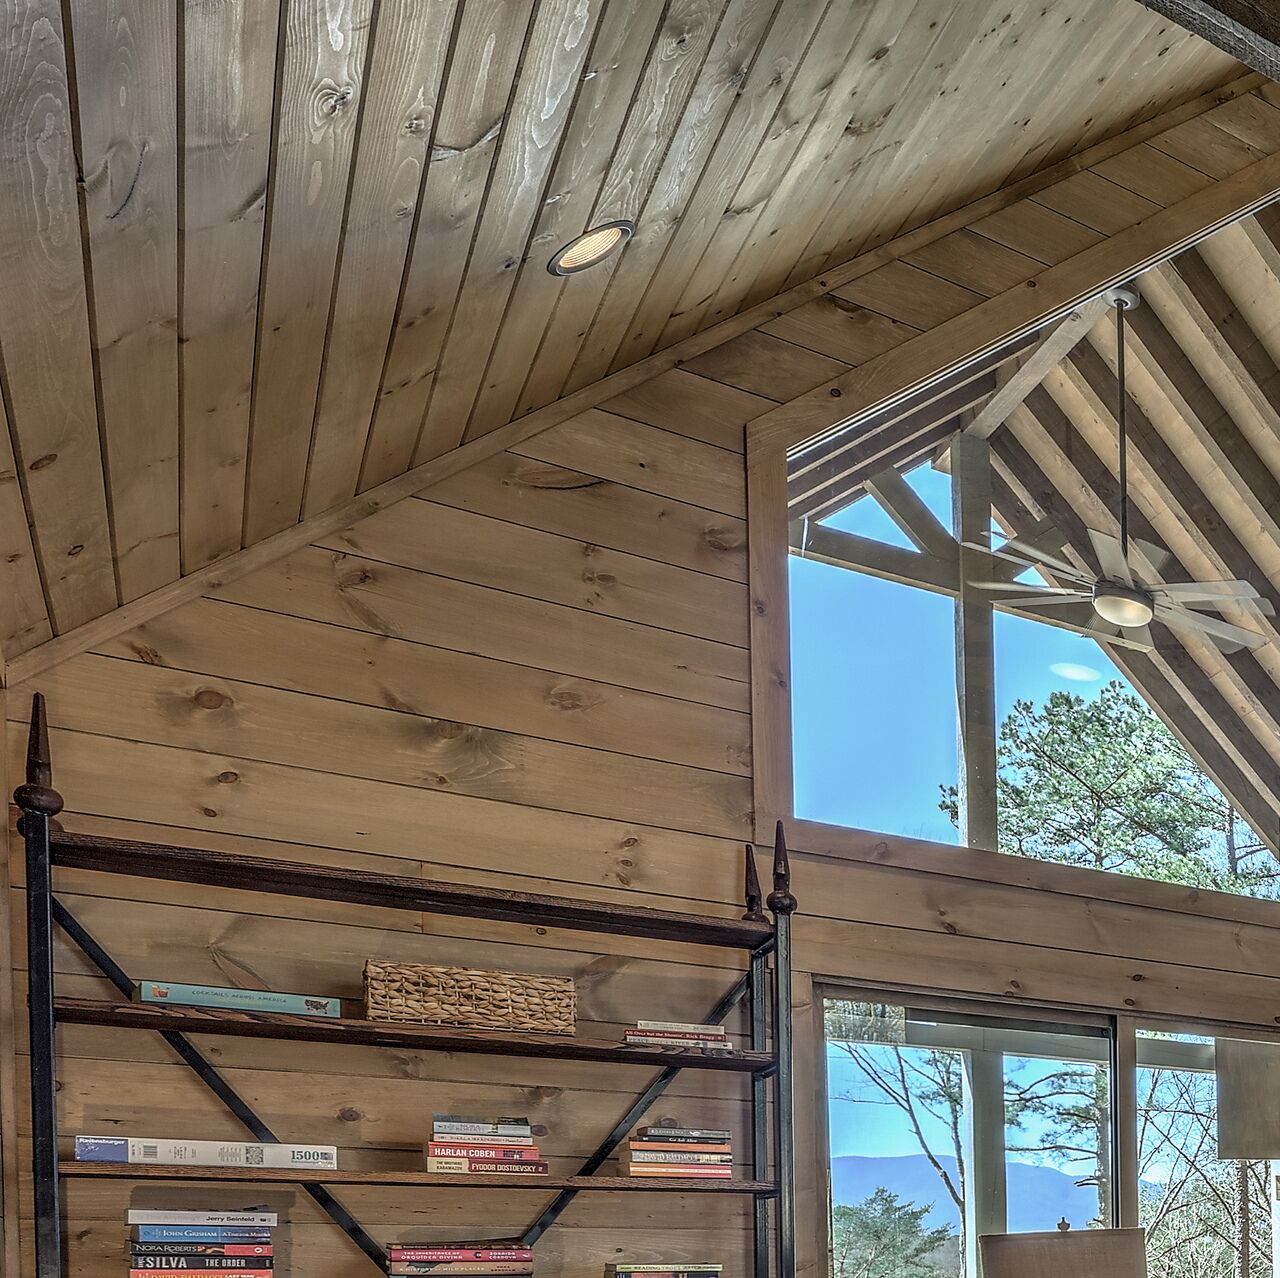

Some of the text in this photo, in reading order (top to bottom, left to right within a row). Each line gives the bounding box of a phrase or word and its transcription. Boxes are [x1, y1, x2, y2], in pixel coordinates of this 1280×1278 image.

[290, 1150, 320, 1161] 1500
[434, 1148, 467, 1157] HARLAN
[469, 1149, 496, 1158] COBEN
[471, 1163, 536, 1172] FYODOR DOSTOEVSKY
[134, 1243, 197, 1254] NORA ROBERTS
[145, 1256, 187, 1268] SILVA
[205, 1258, 246, 1267] THE ORDER
